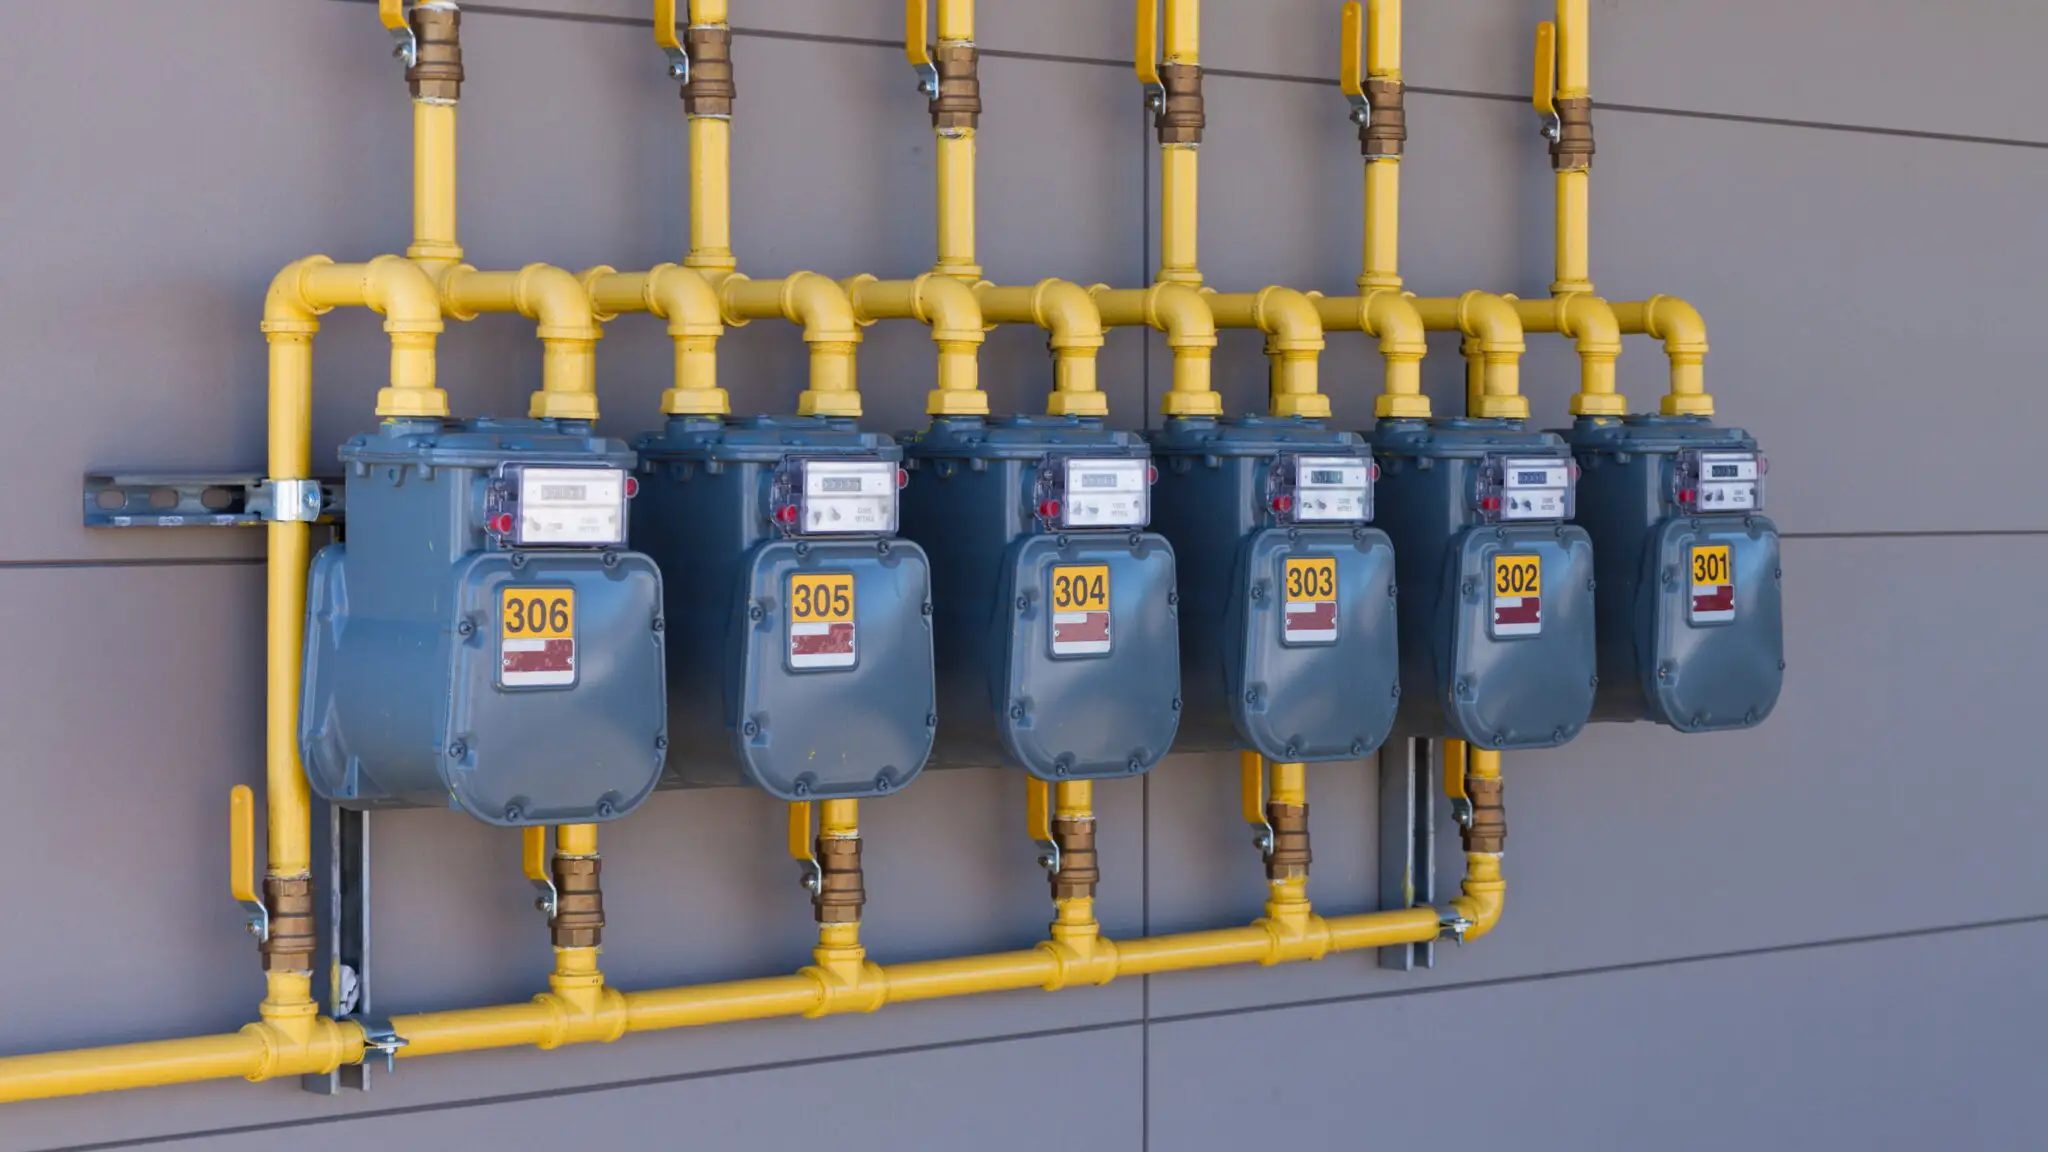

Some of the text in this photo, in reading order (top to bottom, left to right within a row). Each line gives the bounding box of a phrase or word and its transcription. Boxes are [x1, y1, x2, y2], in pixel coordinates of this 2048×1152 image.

[1289, 567, 1332, 597] 303
[1497, 564, 1537, 592] 302
[1695, 553, 1727, 581] 301
[794, 584, 849, 617] 305
[1056, 575, 1105, 607] 304
[506, 598, 568, 632] 306
